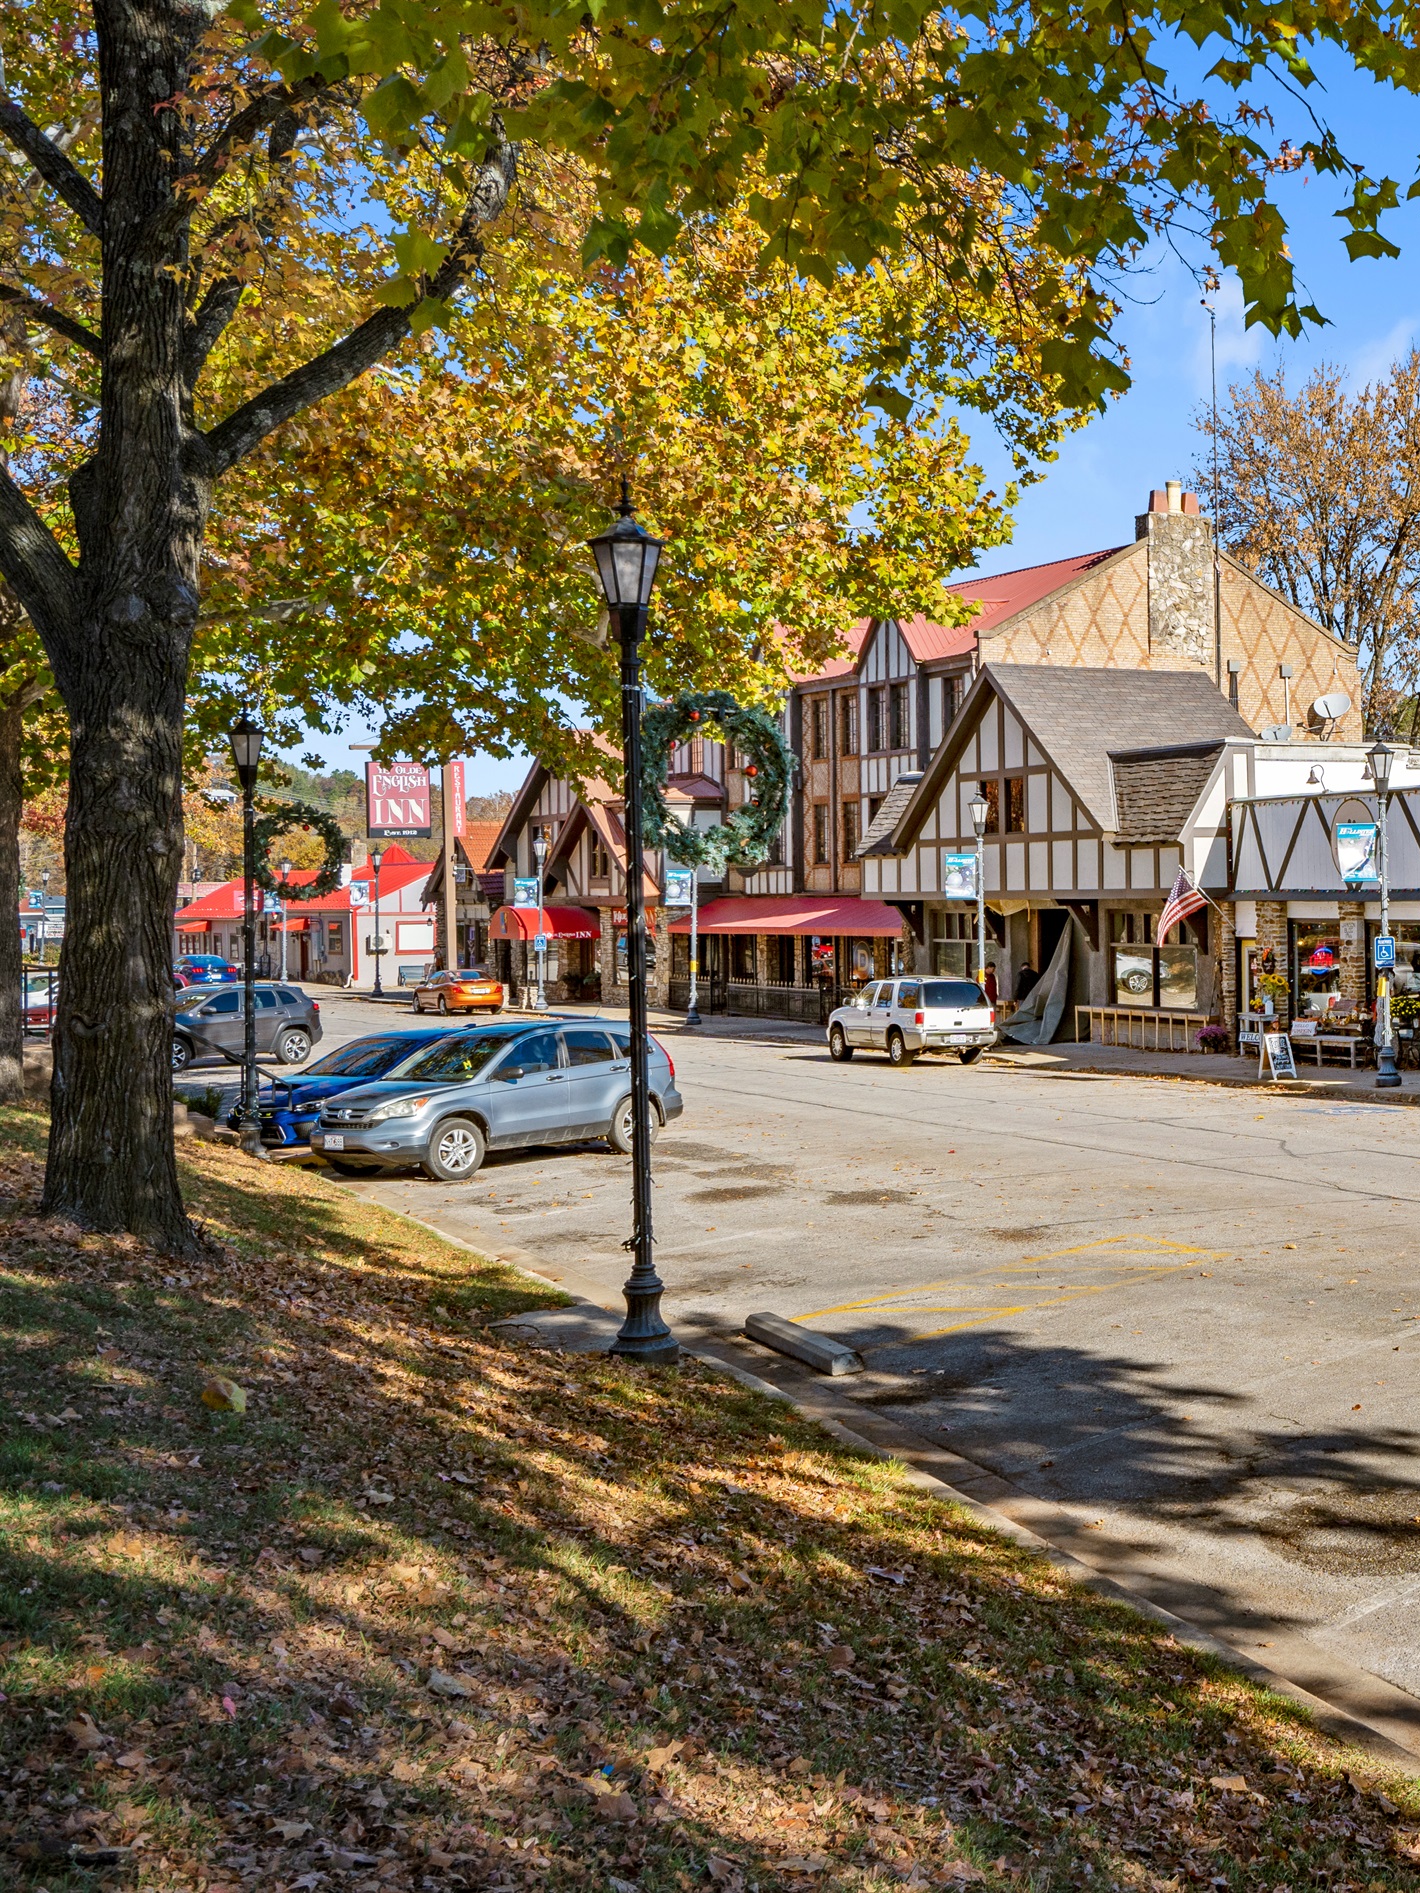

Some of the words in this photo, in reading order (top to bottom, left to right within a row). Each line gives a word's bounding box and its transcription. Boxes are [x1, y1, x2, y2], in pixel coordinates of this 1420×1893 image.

[395, 765, 422, 774] OLDE
[372, 774, 427, 796] ENGLISH
[453, 765, 462, 833] RESTAURANT
[373, 798, 427, 825] INN
[575, 930, 592, 938] INN
